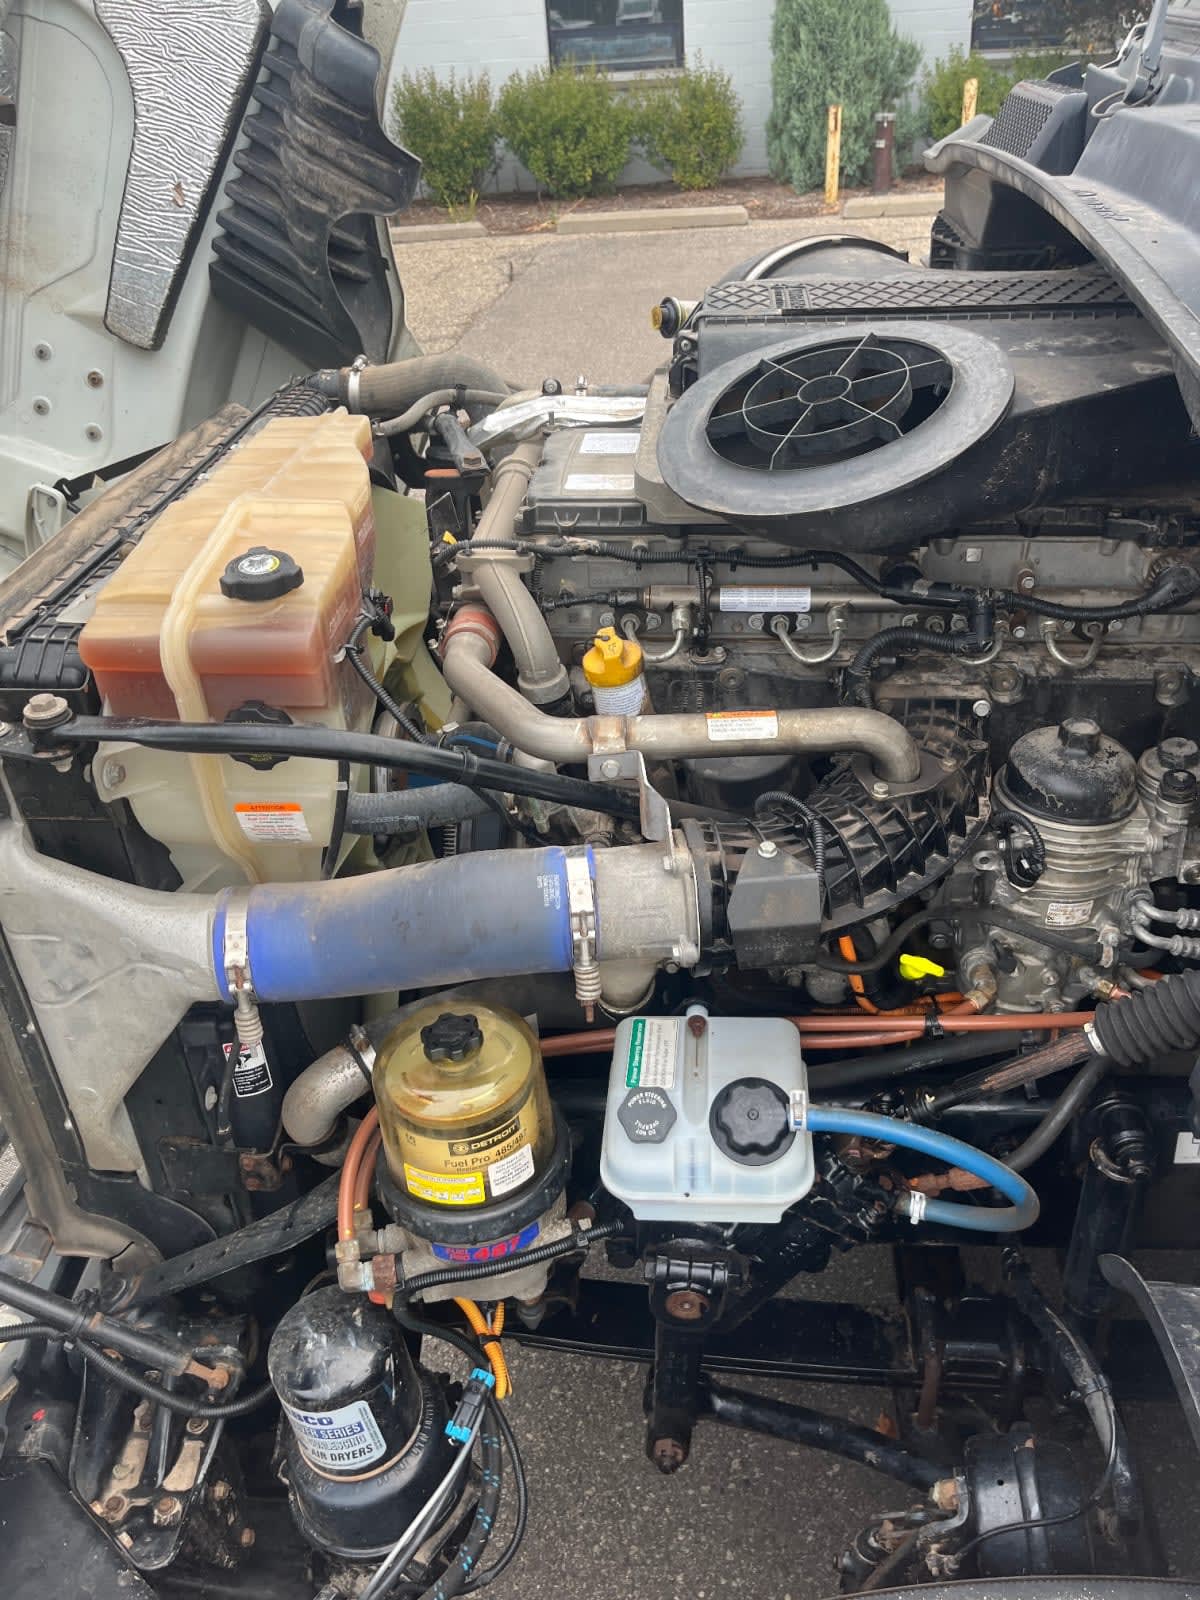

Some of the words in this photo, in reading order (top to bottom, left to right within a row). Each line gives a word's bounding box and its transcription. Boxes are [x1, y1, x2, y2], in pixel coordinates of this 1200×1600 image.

[627, 1092, 644, 1108] POWER
[644, 1091, 667, 1109] STEERING
[471, 1123, 516, 1150] DETROIT
[648, 1128, 656, 1136] DO
[444, 1158, 468, 1168] Fuel
[471, 1155, 491, 1166] Pro
[473, 1235, 520, 1260] 487
[320, 1422, 362, 1439] SERIES
[311, 1449, 328, 1460] AIR
[330, 1443, 374, 1462] DRYERS
